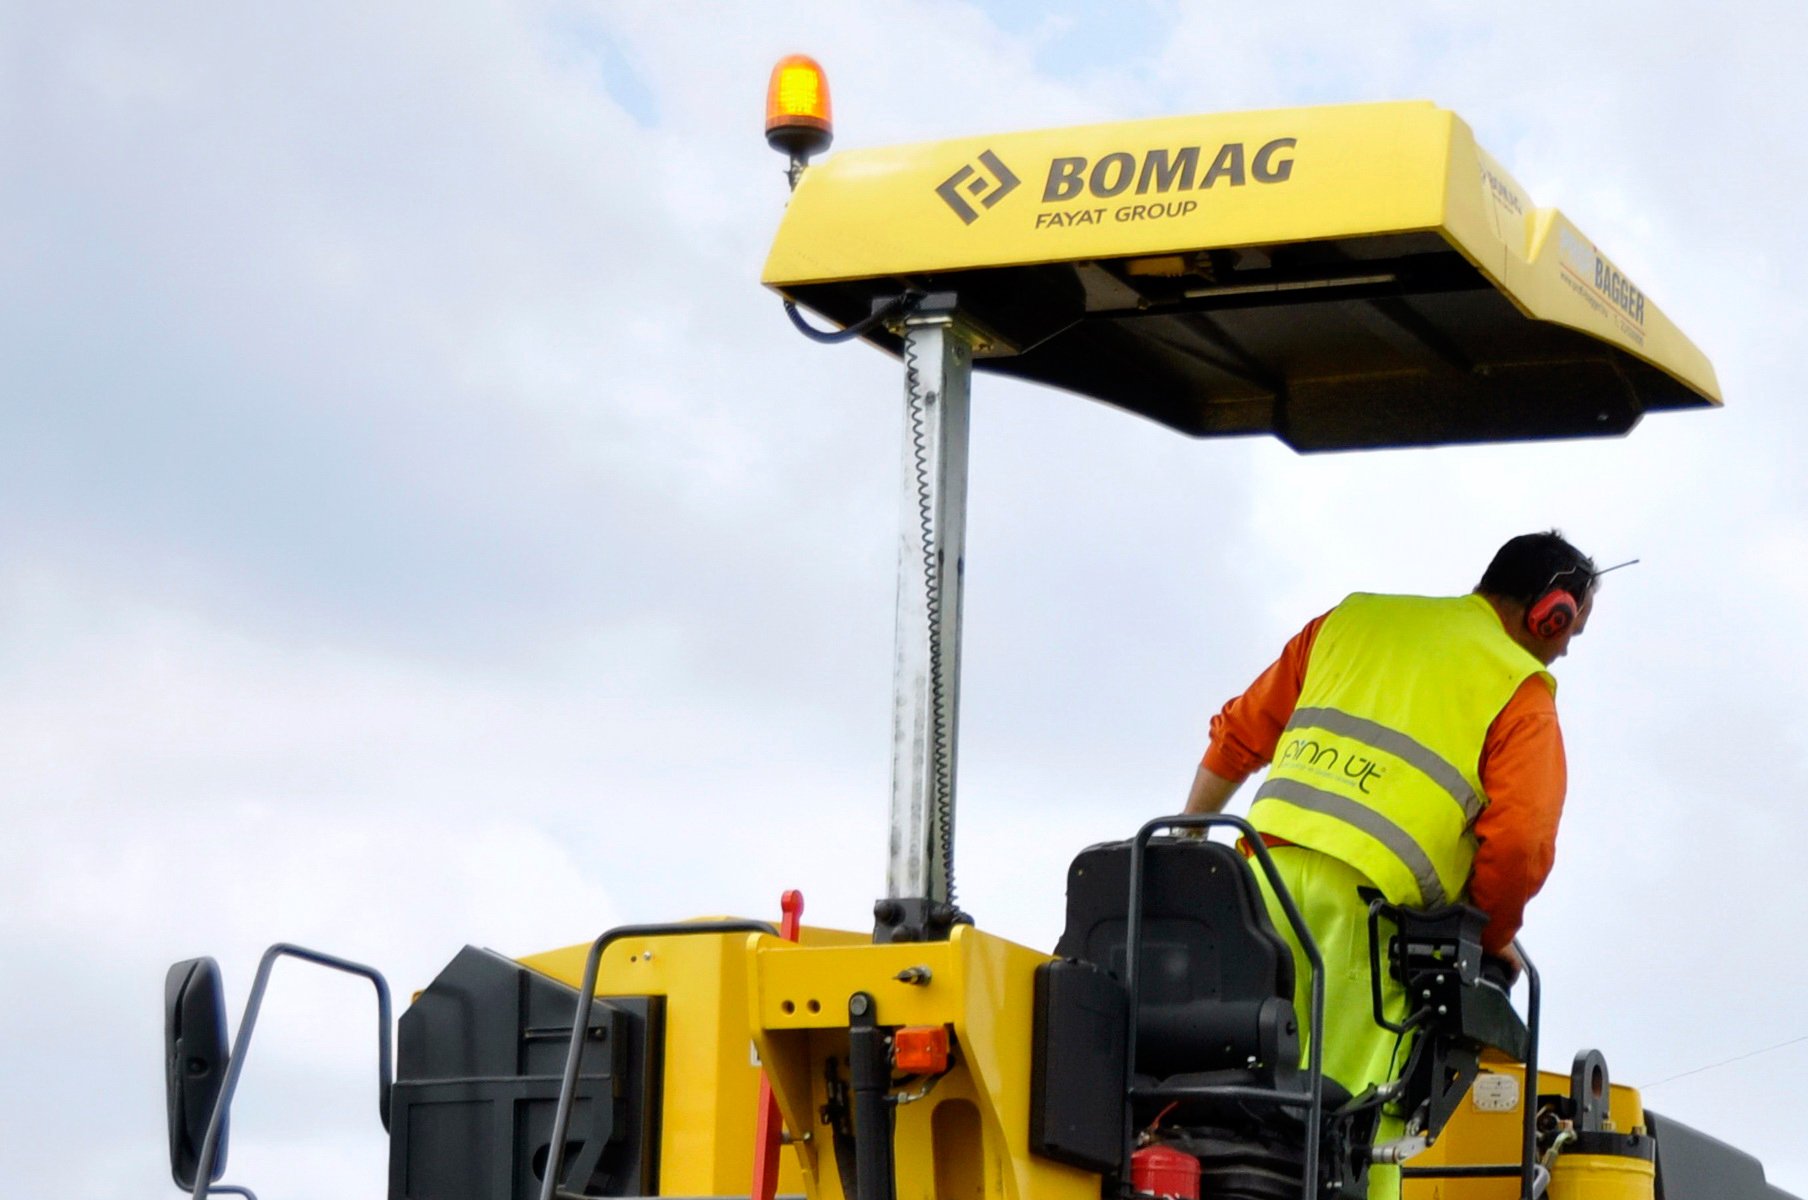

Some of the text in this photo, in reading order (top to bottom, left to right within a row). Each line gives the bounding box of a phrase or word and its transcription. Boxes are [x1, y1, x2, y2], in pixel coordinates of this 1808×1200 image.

[1042, 137, 1297, 203] BOMAG
[1035, 200, 1197, 229] FAYAT GROUP
[1595, 257, 1645, 326] BAGGER
